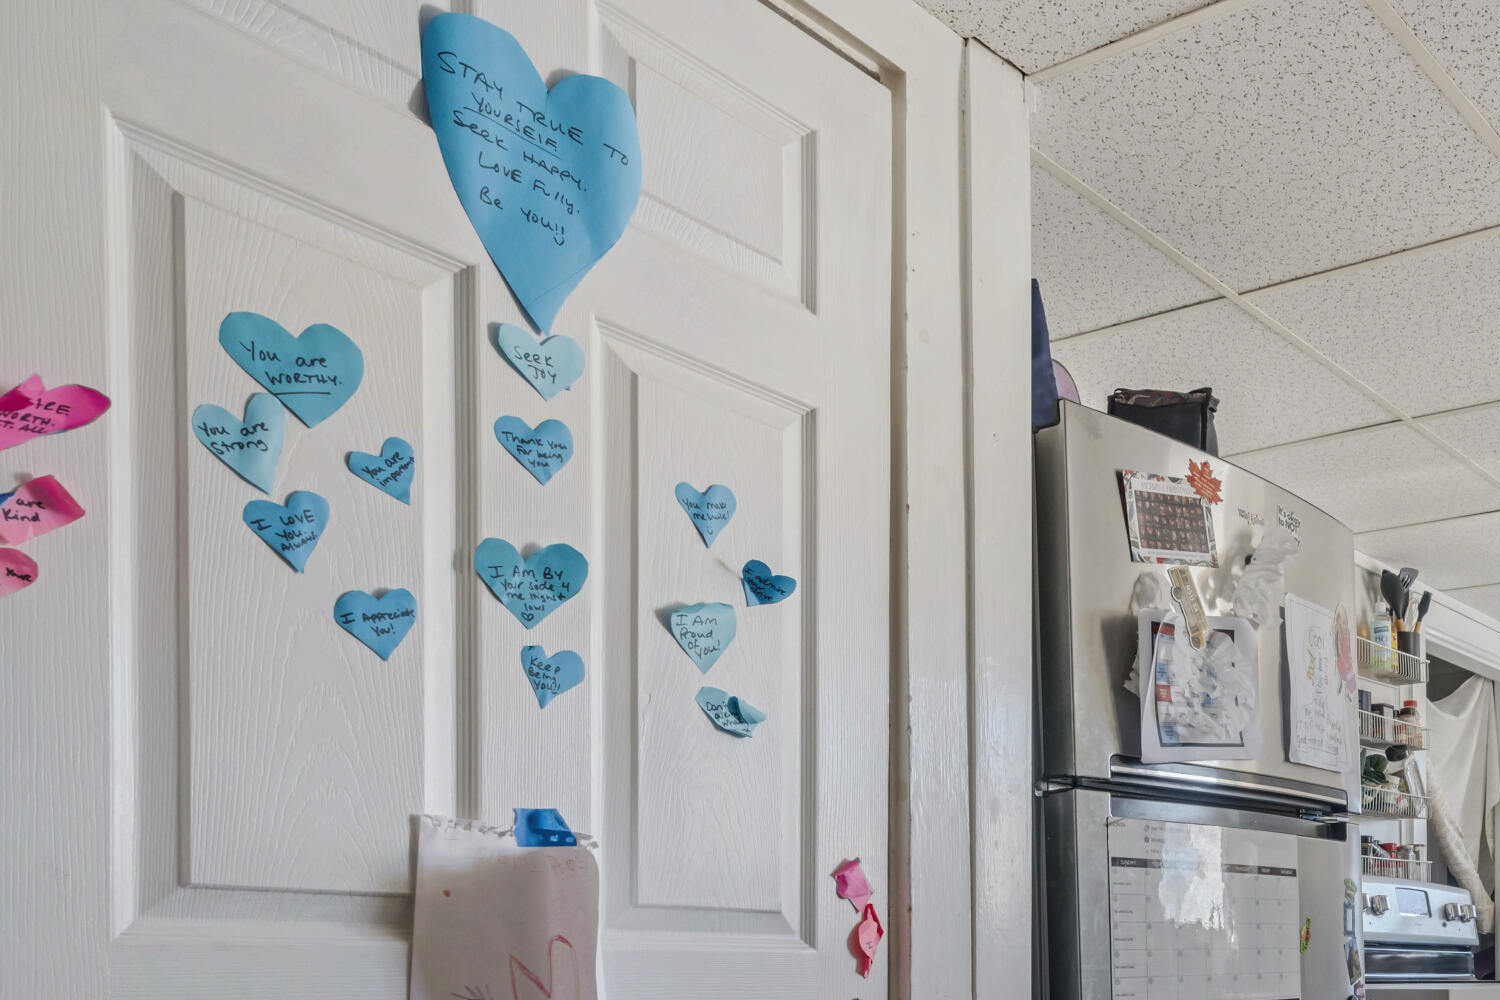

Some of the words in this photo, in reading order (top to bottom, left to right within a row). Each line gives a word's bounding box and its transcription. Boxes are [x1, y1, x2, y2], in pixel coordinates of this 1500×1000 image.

[437, 51, 503, 101] STAY
[516, 100, 585, 146] TRUE
[603, 143, 629, 166] TO
[239, 341, 281, 361] You
[295, 356, 328, 368] are
[240, 421, 269, 437] are
[501, 431, 544, 447] Thank
[384, 451, 405, 467] are
[249, 518, 273, 531] I
[487, 565, 505, 578] I
[339, 612, 356, 625] I
[675, 613, 689, 626] I
